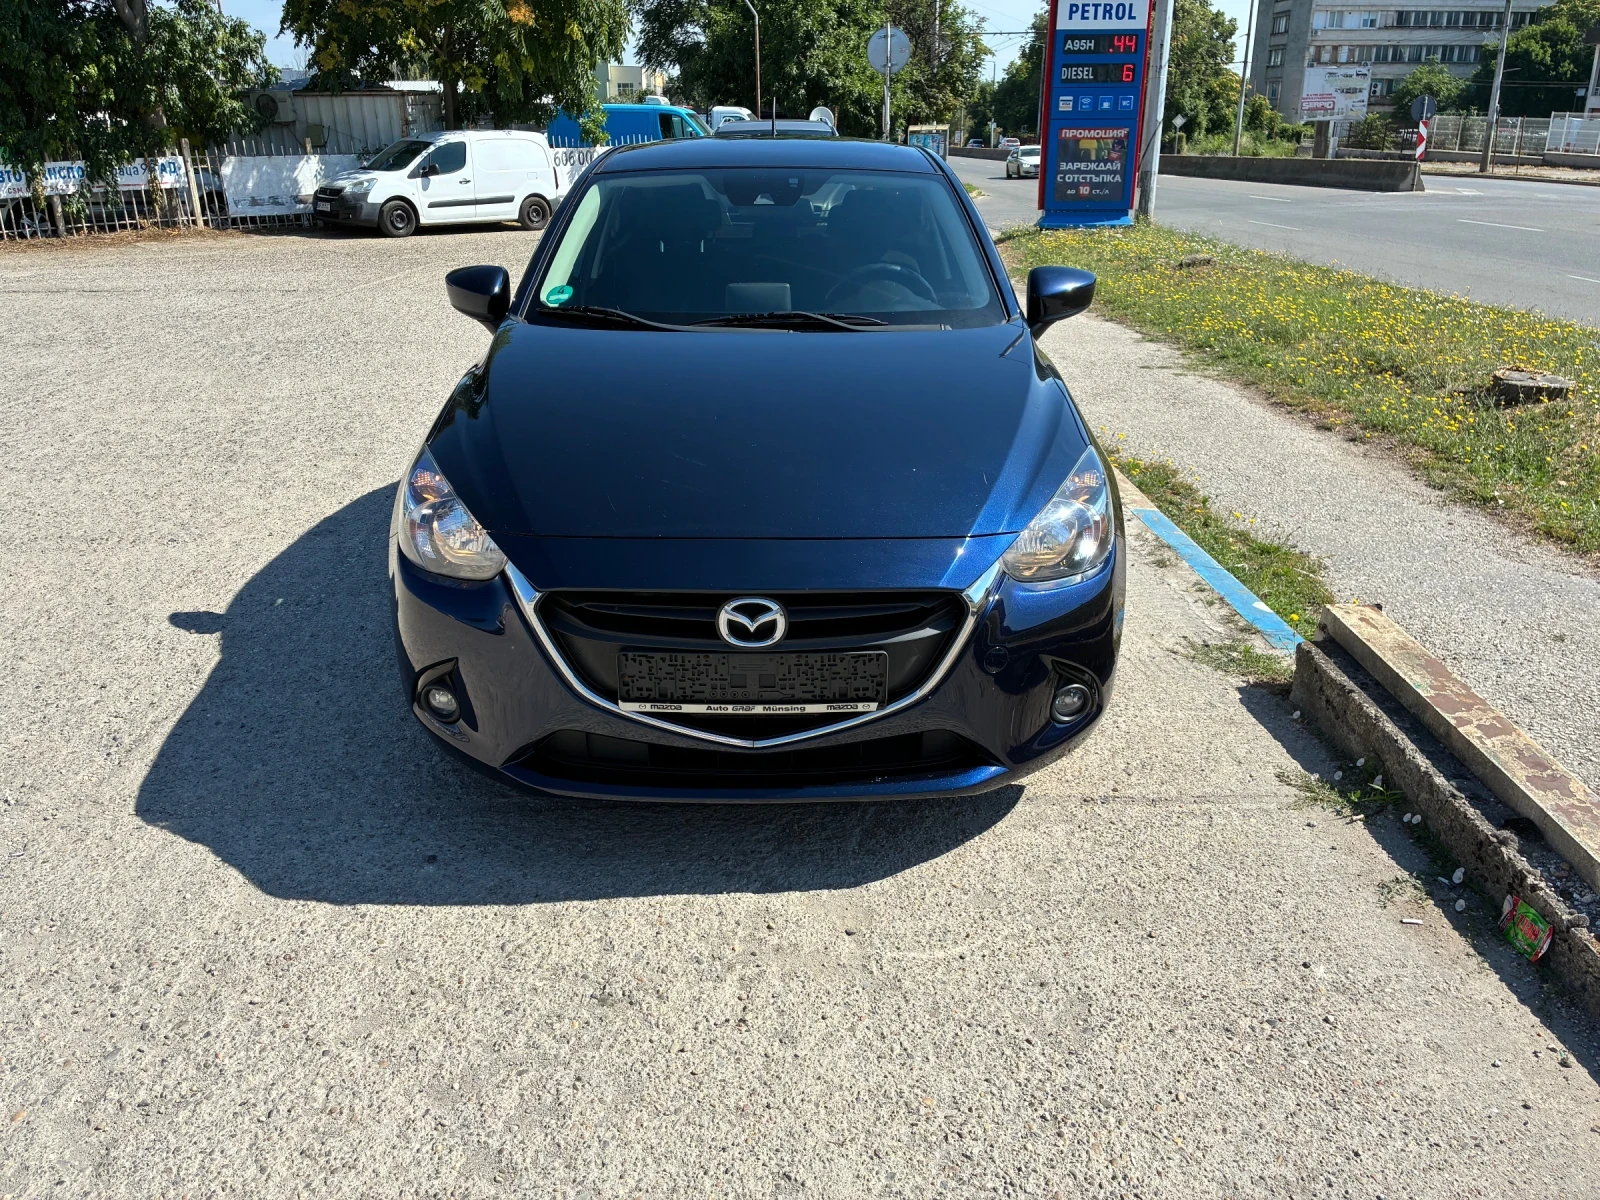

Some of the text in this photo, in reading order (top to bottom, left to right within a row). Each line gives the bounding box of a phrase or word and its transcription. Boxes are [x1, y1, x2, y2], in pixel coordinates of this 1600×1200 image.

[1068, 3, 1136, 20] PETROL
[1064, 39, 1094, 50] A95H
[1061, 64, 1134, 81] DIESEL 6
[1061, 129, 1125, 138] ПРОМОЦИЯ
[554, 150, 575, 167] 606
[160, 161, 179, 177] АД
[1059, 160, 1121, 170] ЗАРЕЖДАЙ
[1057, 174, 1122, 183] С ОТСТЪПКА
[1079, 186, 1090, 195] 10
[762, 705, 806, 713] Münsing
